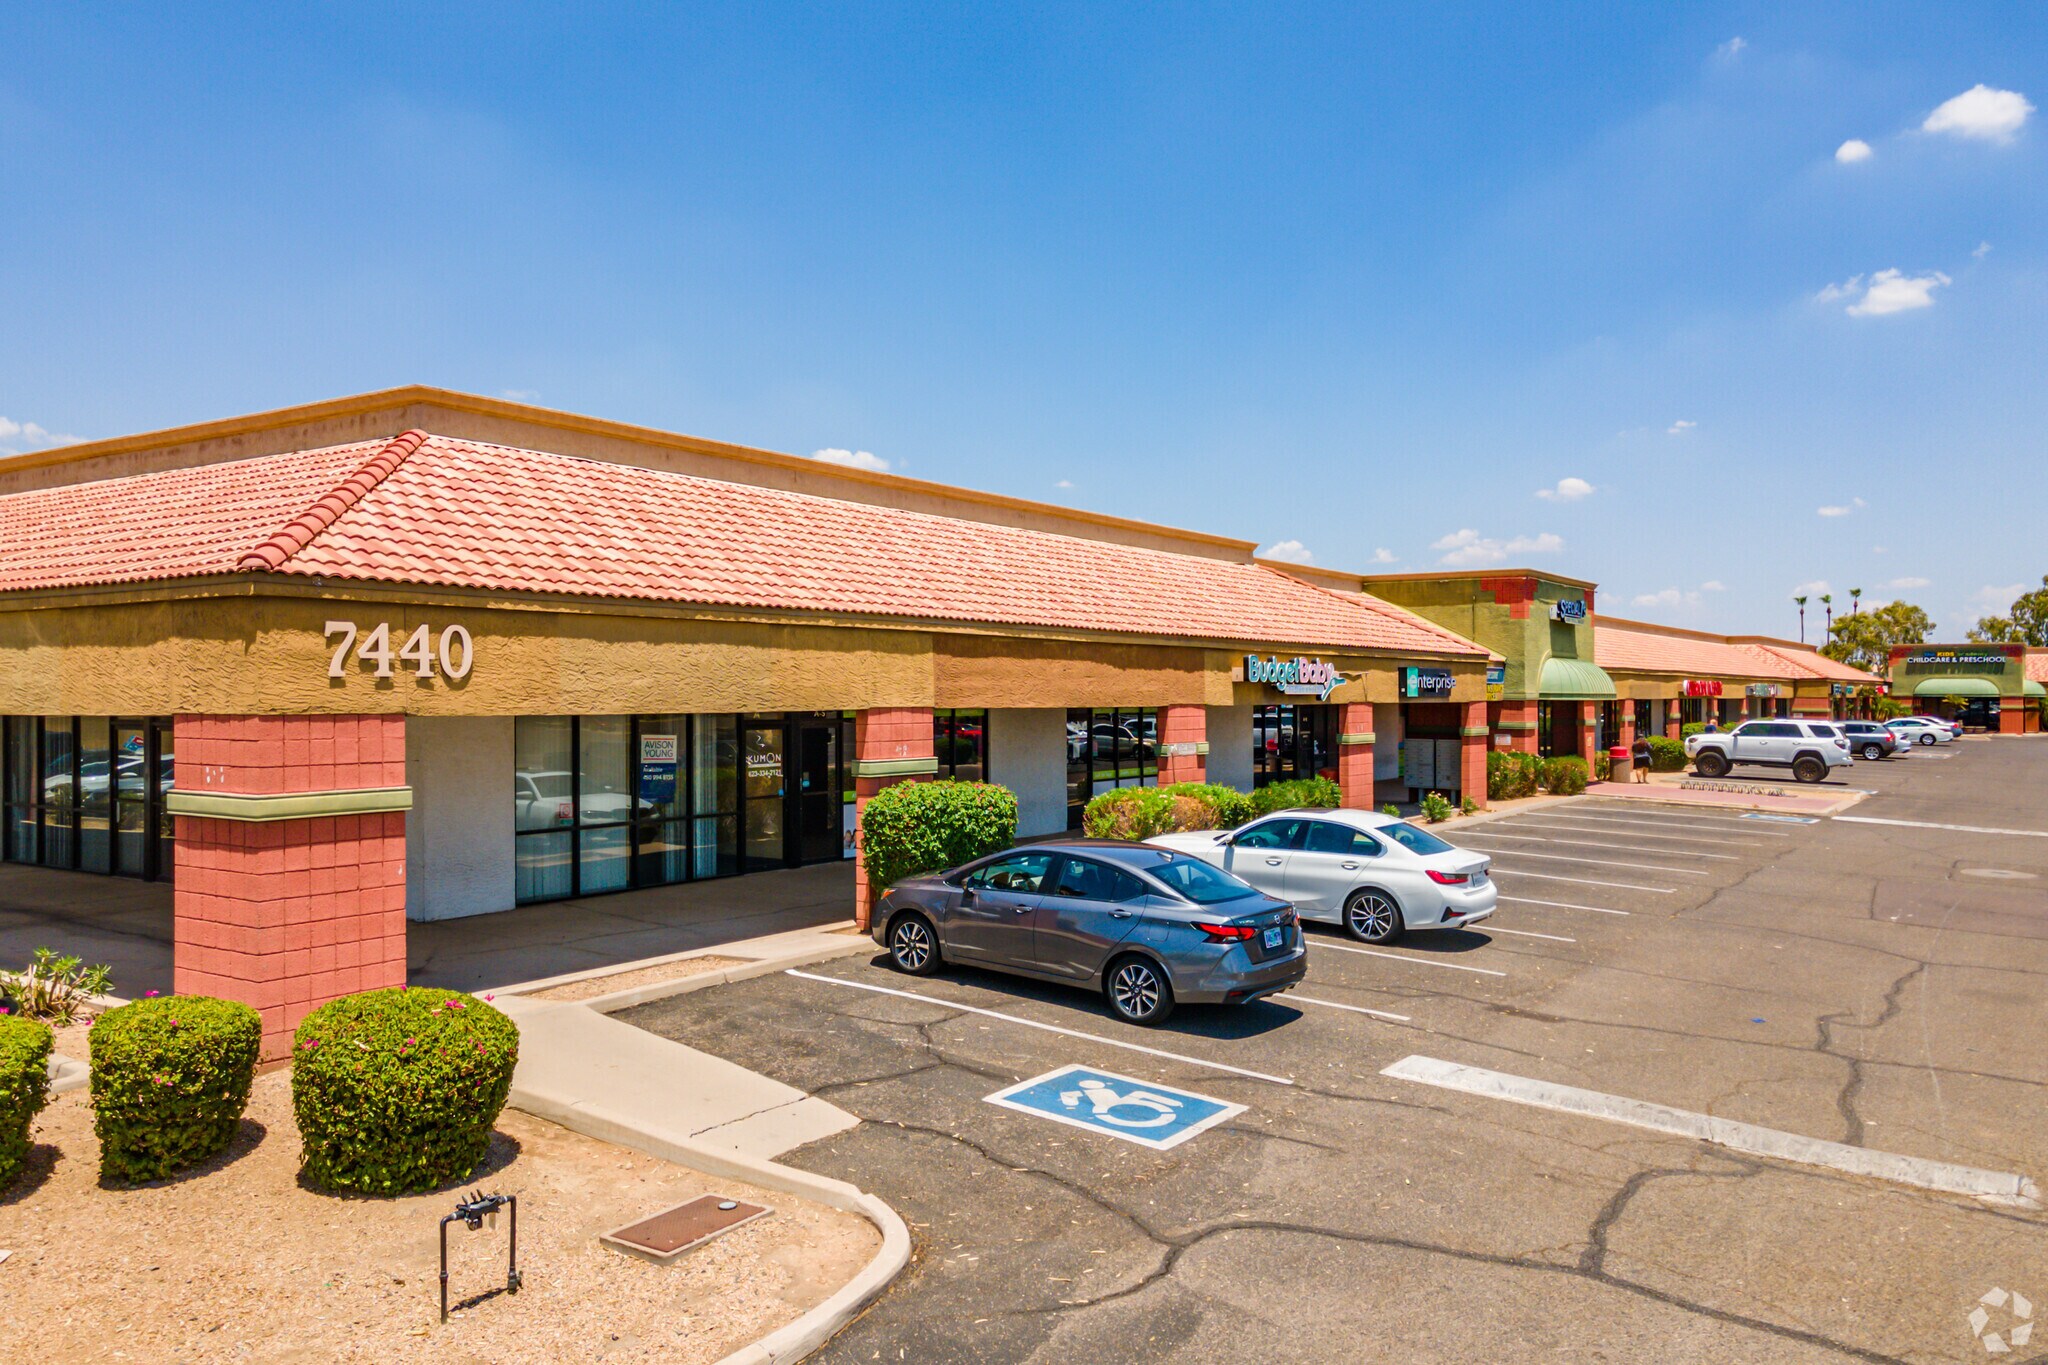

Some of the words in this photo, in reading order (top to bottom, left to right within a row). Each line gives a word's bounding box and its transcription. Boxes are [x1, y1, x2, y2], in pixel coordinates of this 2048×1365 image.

[324, 620, 474, 679] 7440
[1408, 673, 1457, 693] enterprise
[644, 740, 674, 749] AVISON
[644, 749, 674, 758] YOUNG
[746, 752, 782, 763] KUMON
